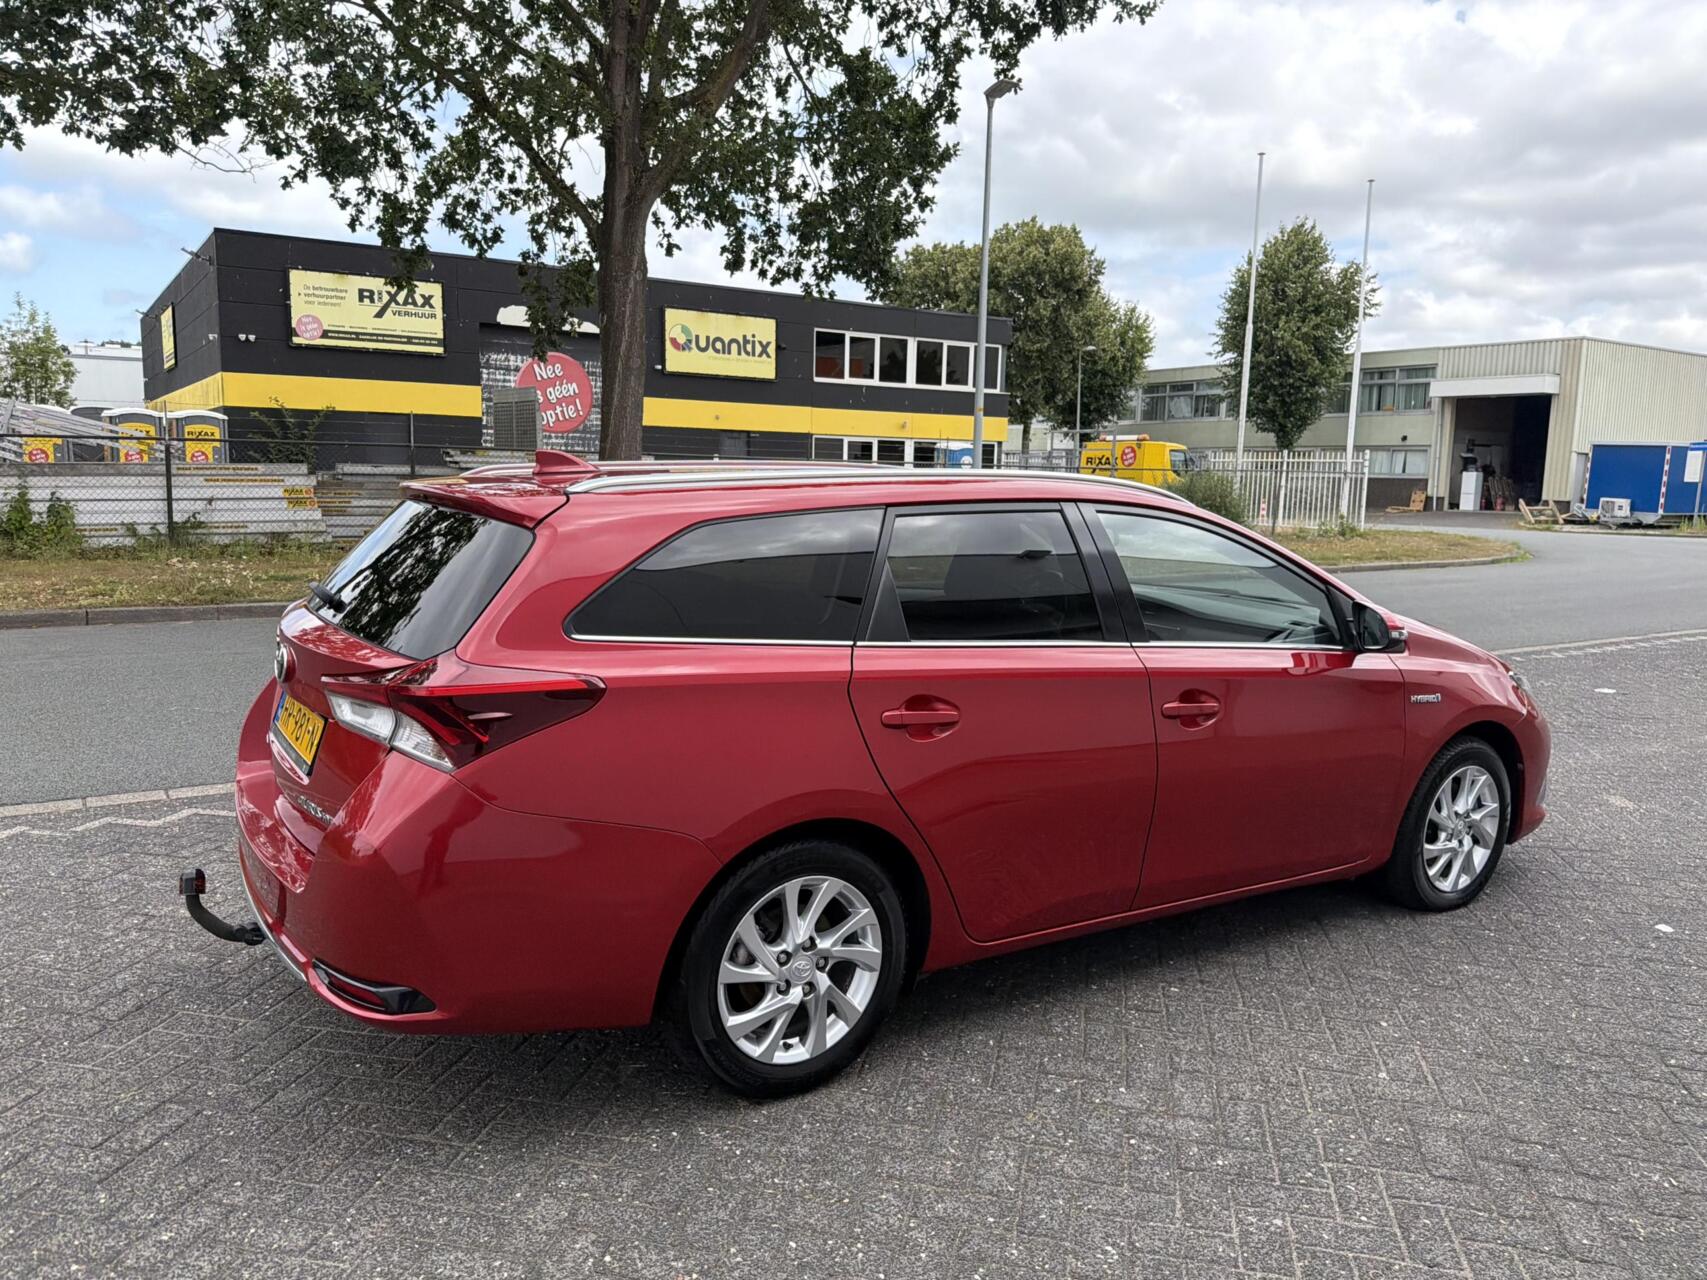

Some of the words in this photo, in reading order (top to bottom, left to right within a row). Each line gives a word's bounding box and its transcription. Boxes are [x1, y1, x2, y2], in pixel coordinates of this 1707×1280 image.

[303, 292, 347, 301] verhuurpartner
[391, 309, 437, 320] VERHUUR
[533, 361, 564, 381] Nee
[536, 390, 544, 404] s
[546, 379, 579, 403] géén
